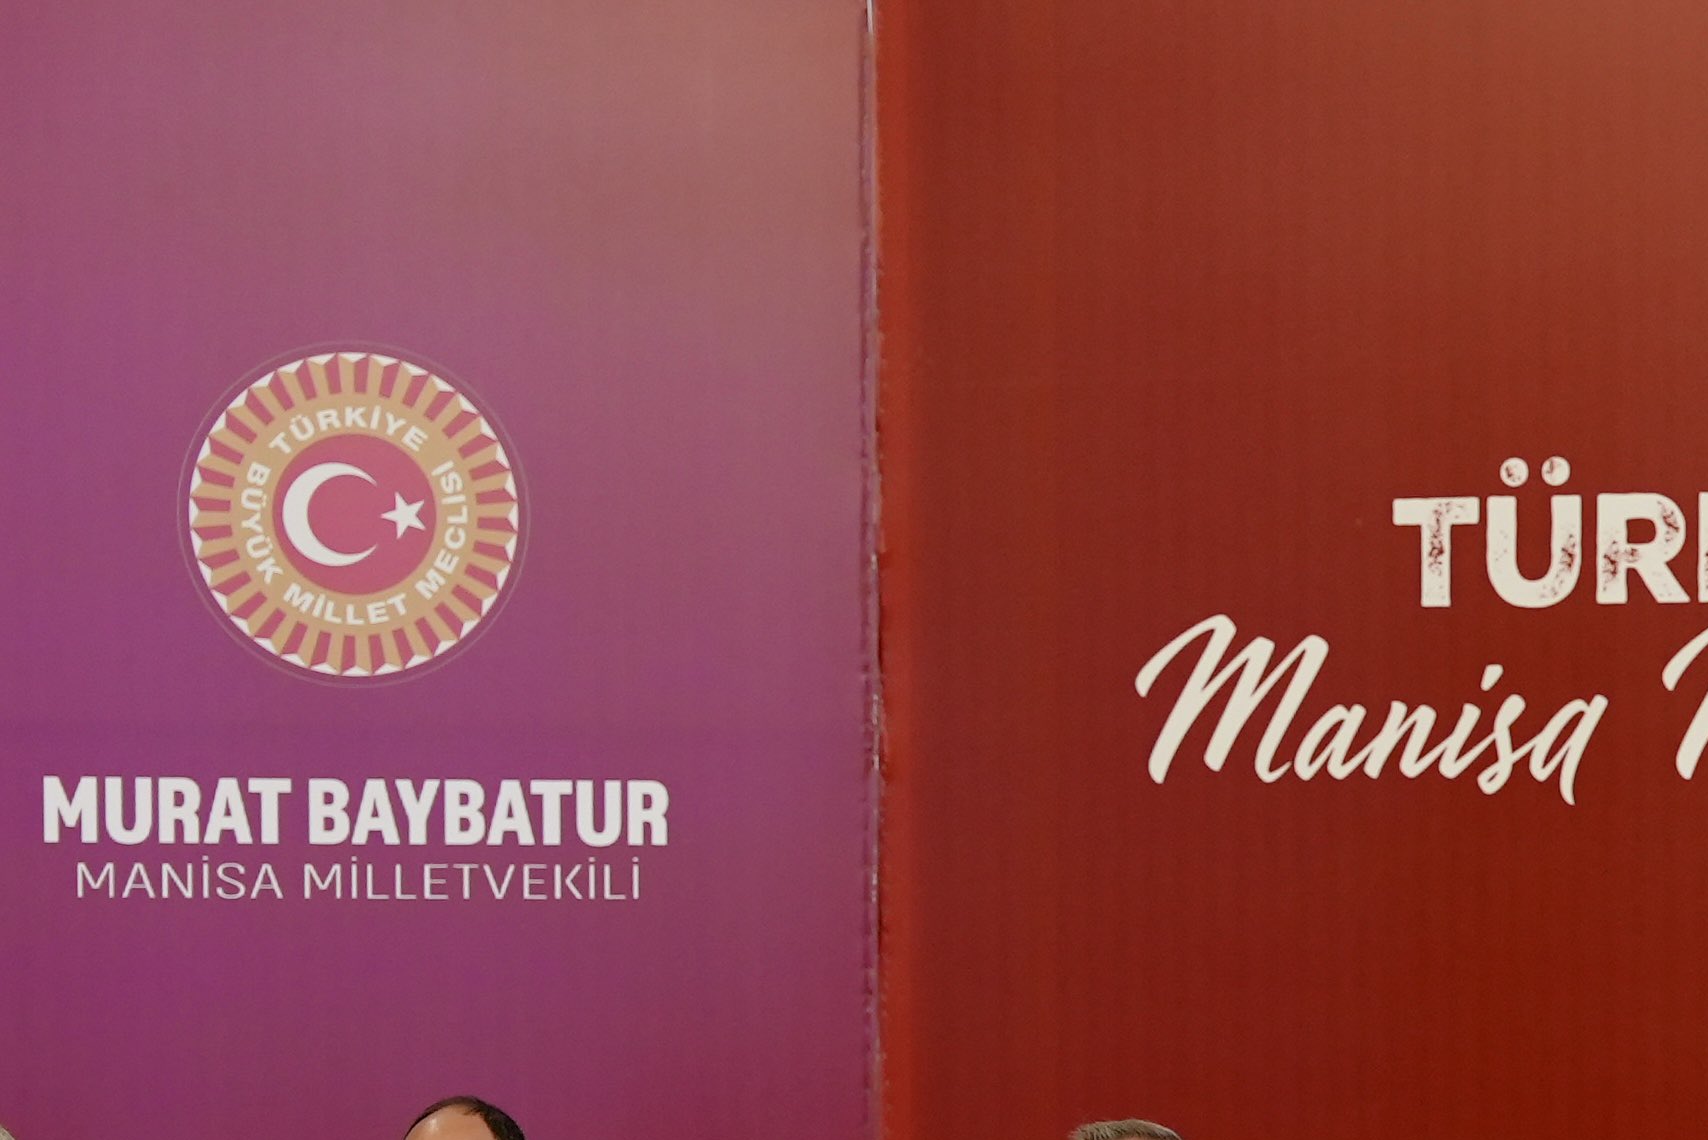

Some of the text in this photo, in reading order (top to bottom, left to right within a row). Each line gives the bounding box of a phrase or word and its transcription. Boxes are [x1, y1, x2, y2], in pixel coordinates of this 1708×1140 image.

[268, 405, 428, 455] TÜRKİYE
[240, 461, 284, 584] BÜYÜK
[283, 582, 407, 625] MİLLET
[1135, 614, 1608, 805] Manisa
[43, 775, 669, 847] MURAT BAYBATUR
[77, 855, 639, 900] MANİSA MİLLETVEKİLİ
